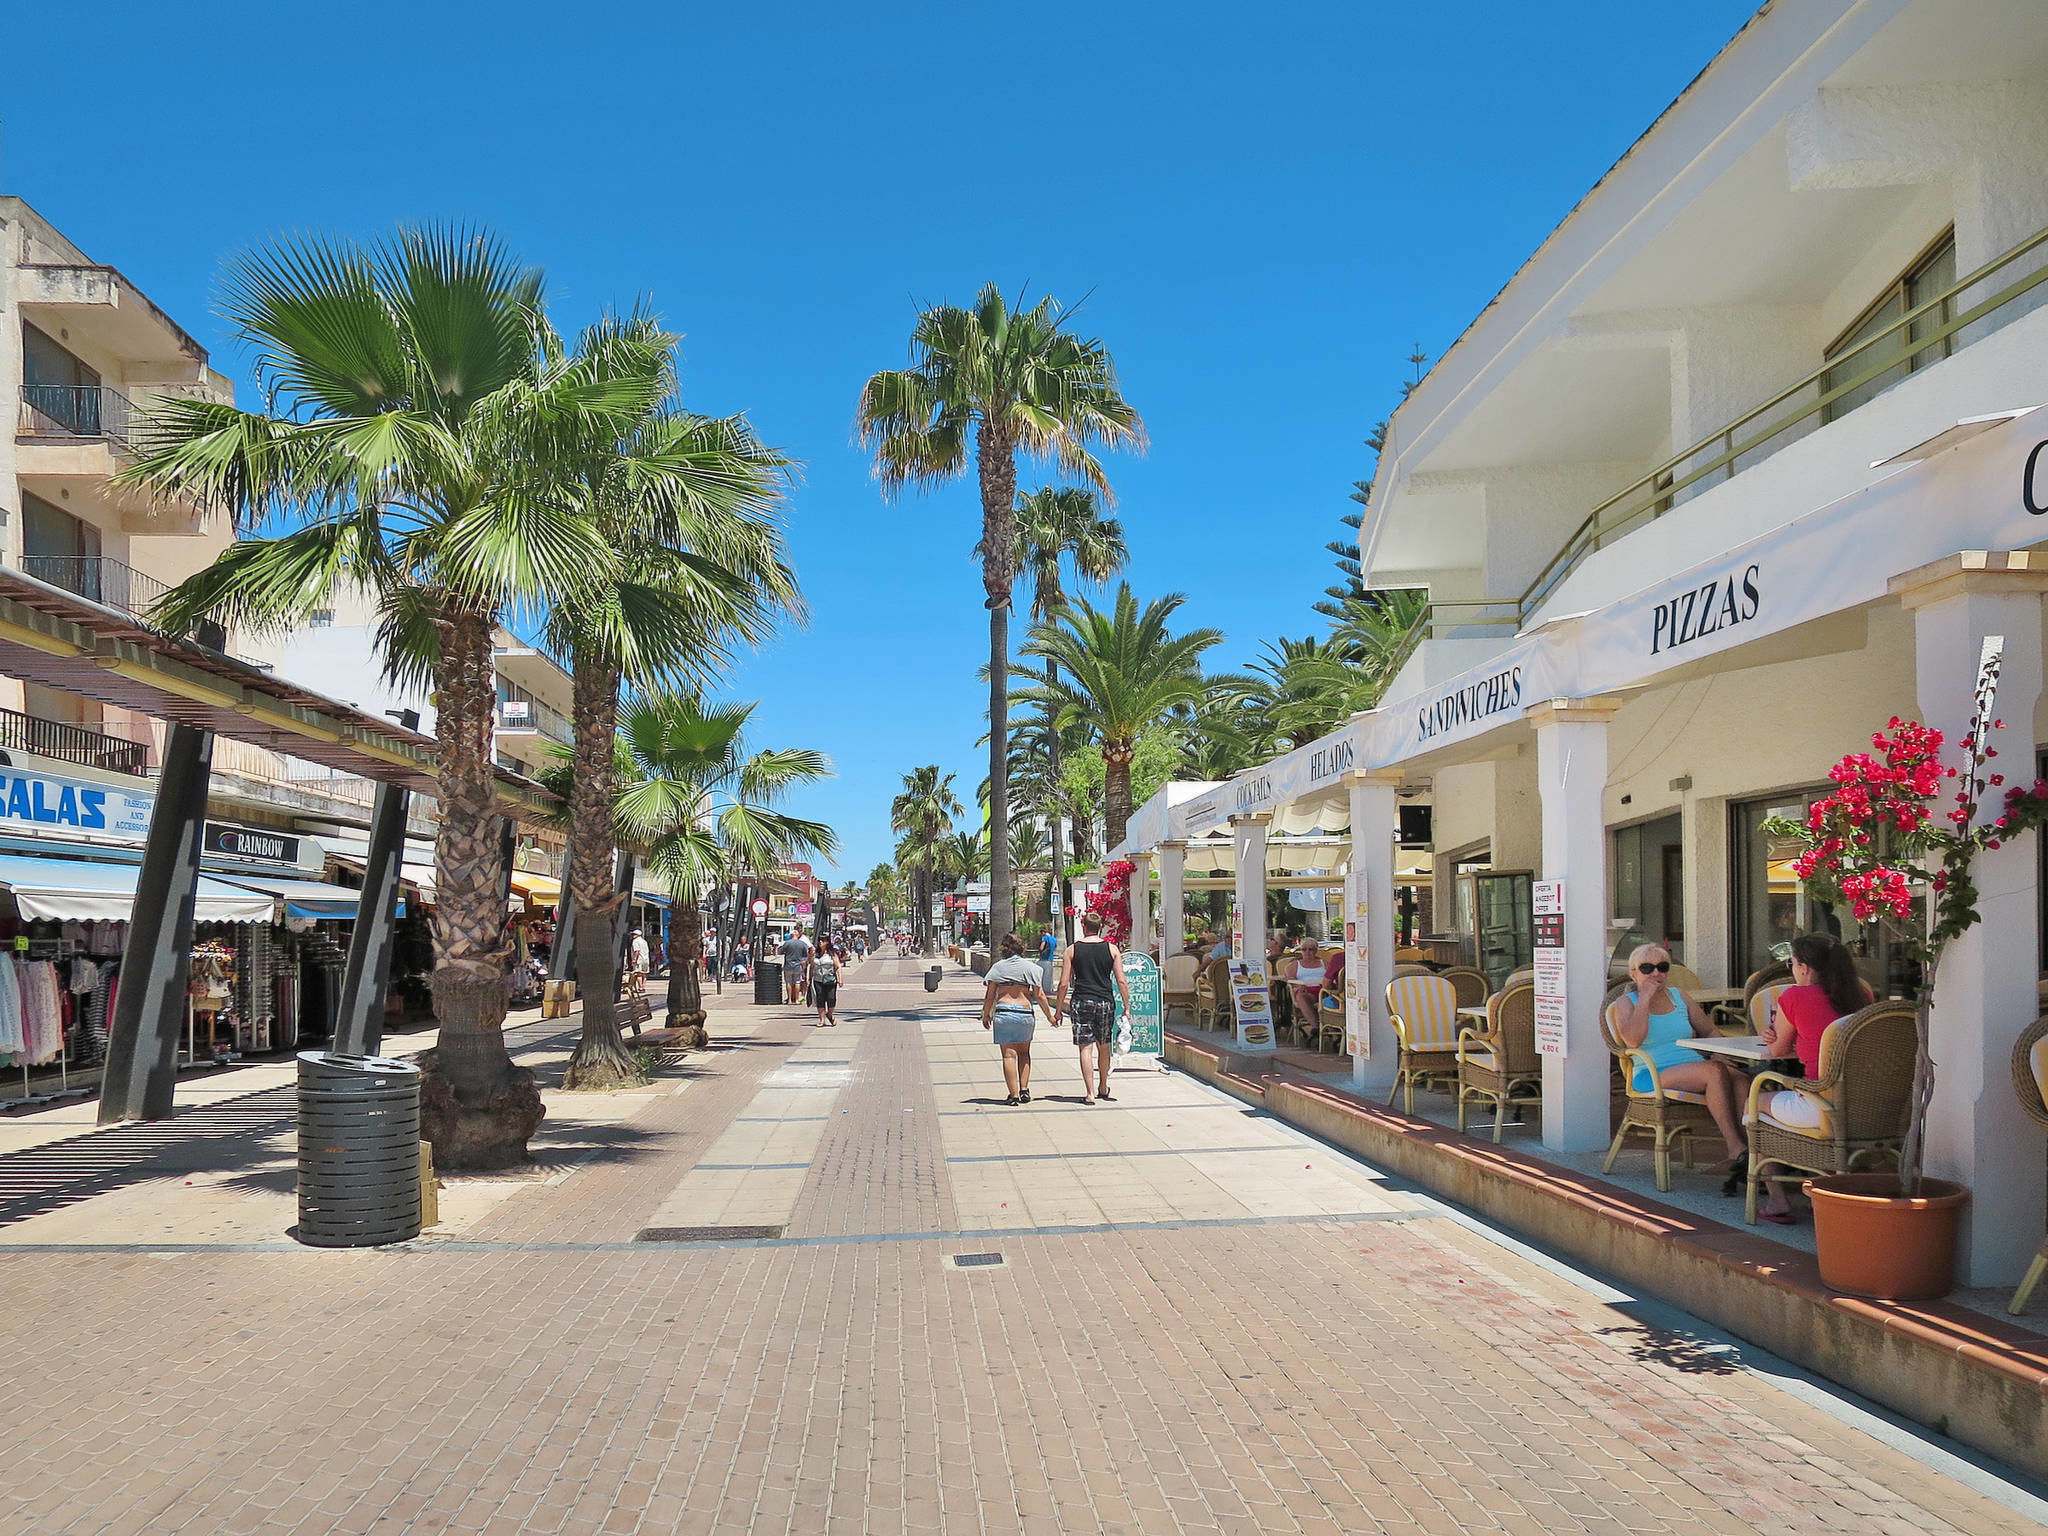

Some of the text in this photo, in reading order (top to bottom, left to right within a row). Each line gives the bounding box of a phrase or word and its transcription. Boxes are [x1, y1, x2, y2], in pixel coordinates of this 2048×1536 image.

[1650, 561, 1760, 656] PIZZAS
[1417, 667, 1522, 742] SANDWICHES
[1310, 738, 1354, 782] HELADOS
[0, 775, 106, 830] ALAS
[129, 811, 145, 821] AND
[237, 833, 284, 858] RAINBOW
